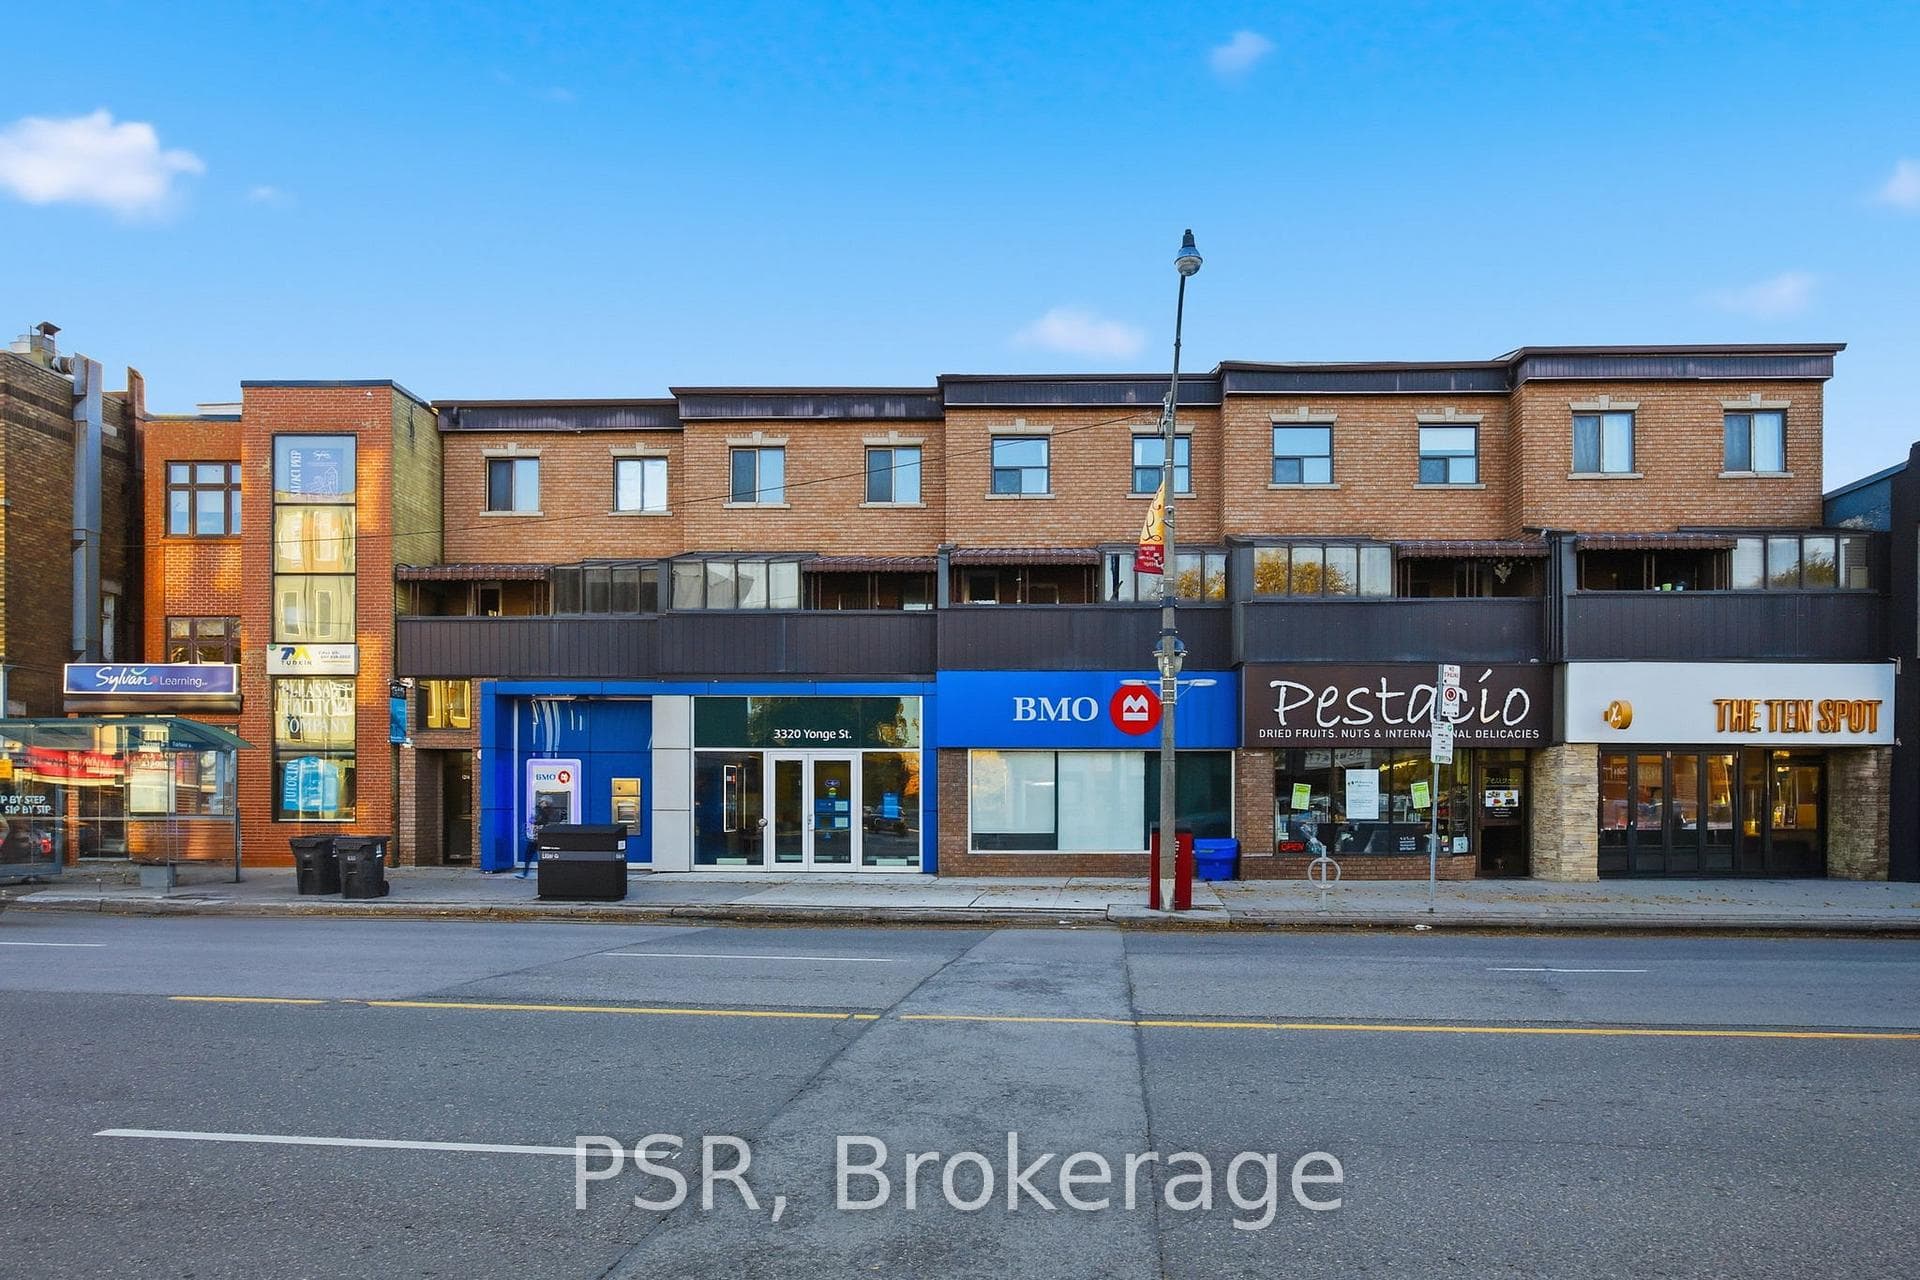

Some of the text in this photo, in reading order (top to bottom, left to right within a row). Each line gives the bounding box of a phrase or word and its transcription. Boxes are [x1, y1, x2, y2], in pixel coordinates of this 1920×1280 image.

[95, 666, 202, 692] Sylvan Learning
[1013, 696, 1099, 722] BMO
[1713, 699, 1883, 734] THE TEN SPOT
[774, 729, 853, 742] 3320 Yonge St.
[1259, 729, 1292, 739] DRIED
[1341, 729, 1370, 739] NUTS
[1374, 729, 1381, 739] &
[1385, 729, 1471, 739] INTERNANAL
[1475, 729, 1540, 739] DELICACIES
[535, 773, 556, 781] BMO
[9, 795, 22, 804] BY
[24, 795, 46, 804] STEP
[5, 805, 52, 814] SIP BY SIP
